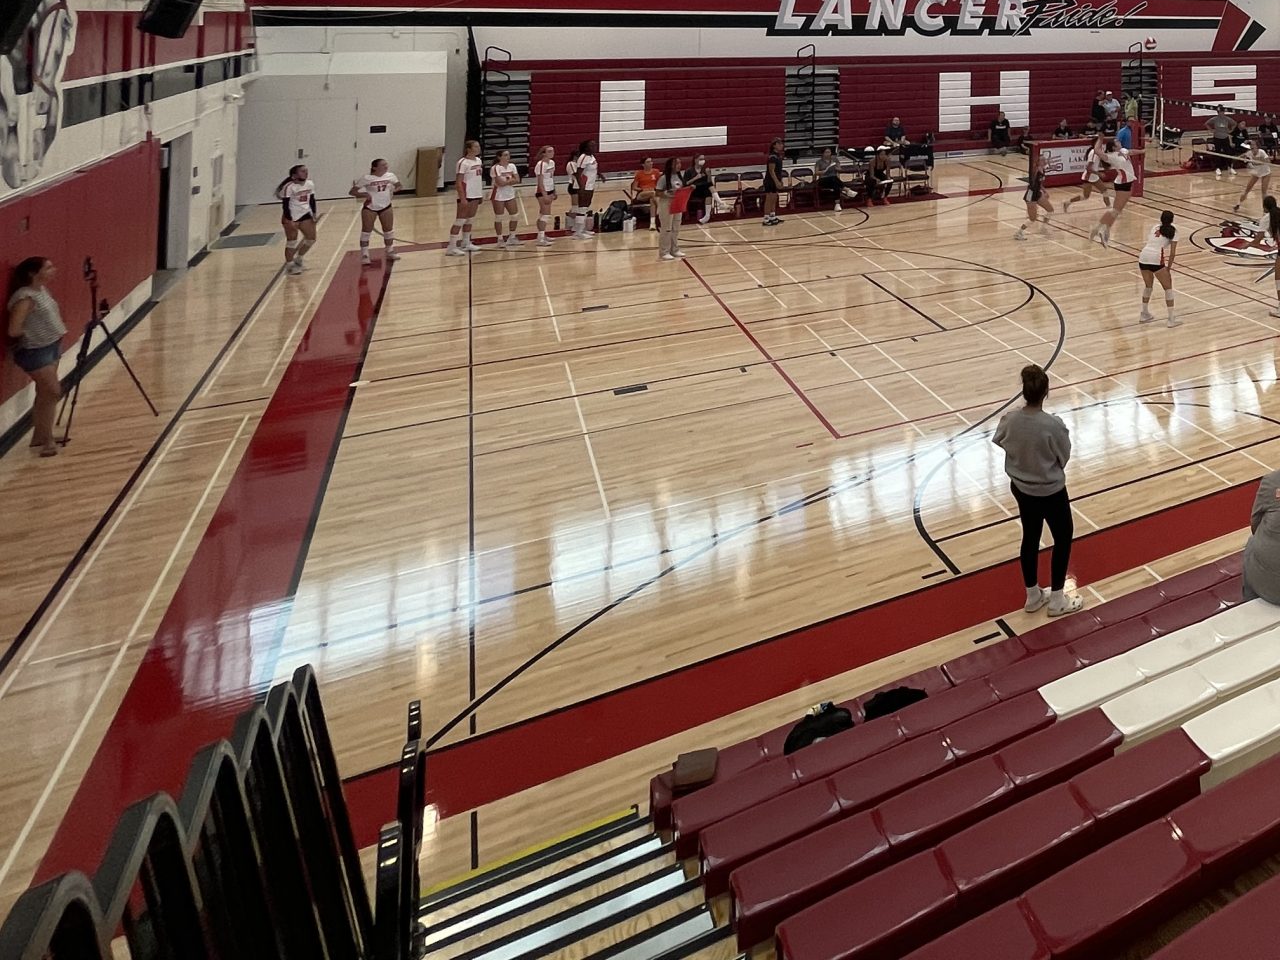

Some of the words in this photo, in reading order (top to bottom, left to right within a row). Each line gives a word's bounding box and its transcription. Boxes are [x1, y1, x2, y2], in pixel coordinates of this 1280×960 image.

[599, 80, 728, 152] L
[938, 70, 1030, 132] H
[1191, 65, 1257, 117] S
